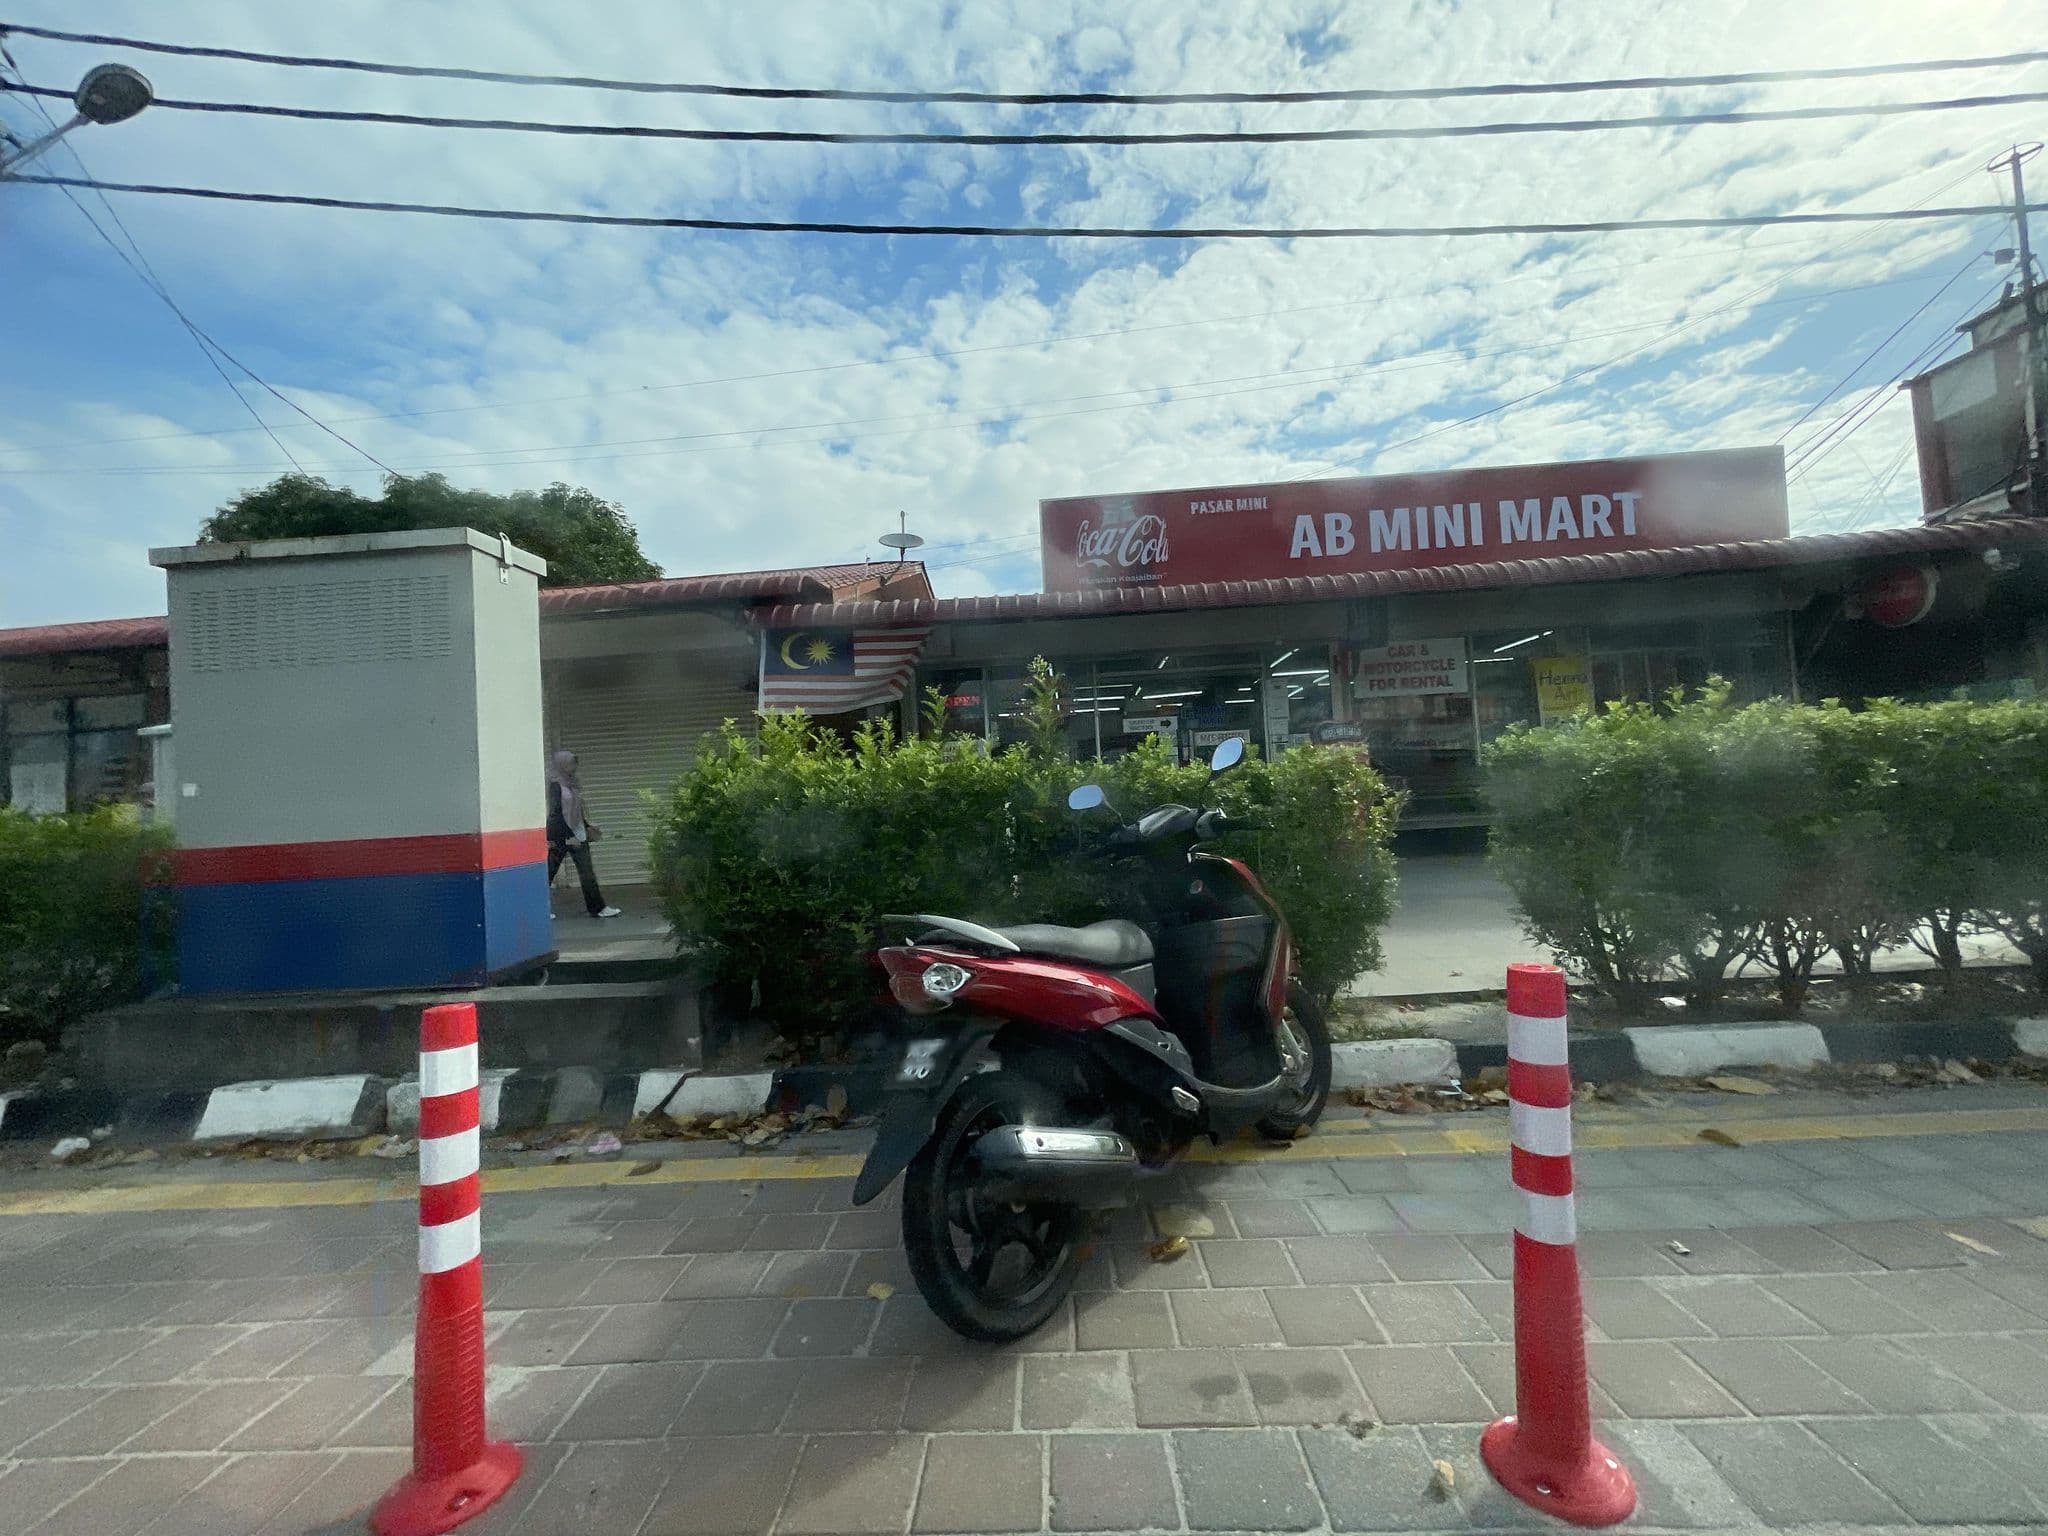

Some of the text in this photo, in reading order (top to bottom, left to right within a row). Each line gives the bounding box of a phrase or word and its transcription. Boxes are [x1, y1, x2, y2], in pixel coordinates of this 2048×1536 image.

[1190, 496, 1269, 515] PASAR MINI
[1289, 491, 1643, 559] AB MINI MART
[1076, 514, 1169, 568] Coca-Cola
[1387, 644, 1416, 657] CAR
[1369, 675, 1453, 691] FOR RENTAL
